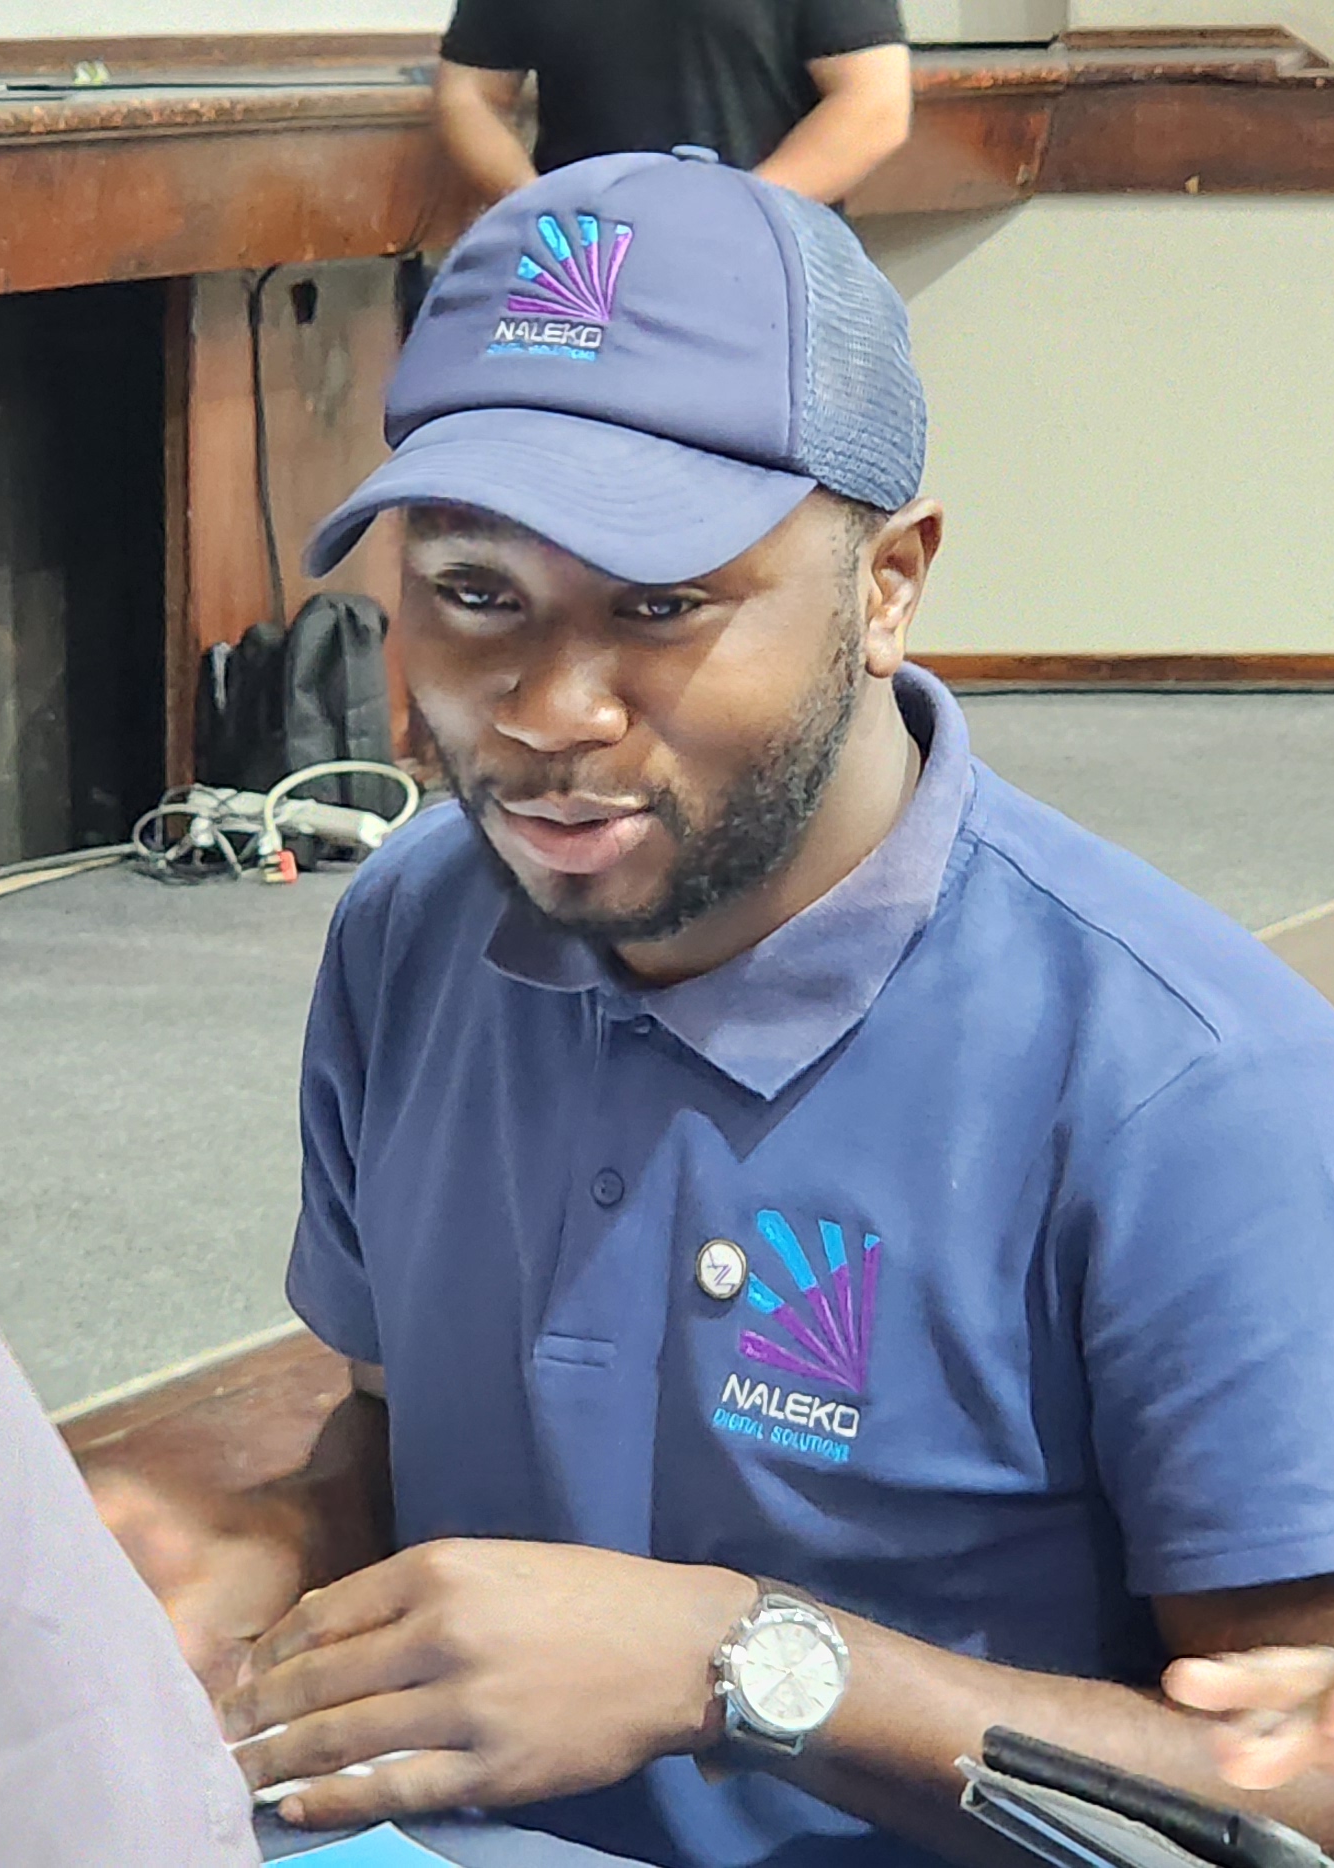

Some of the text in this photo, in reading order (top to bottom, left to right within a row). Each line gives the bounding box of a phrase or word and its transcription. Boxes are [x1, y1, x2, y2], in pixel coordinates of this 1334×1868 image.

[495, 321, 602, 347] NALEKO
[722, 1373, 860, 1437] NALEKO
[713, 1408, 764, 1440] DIGITAL
